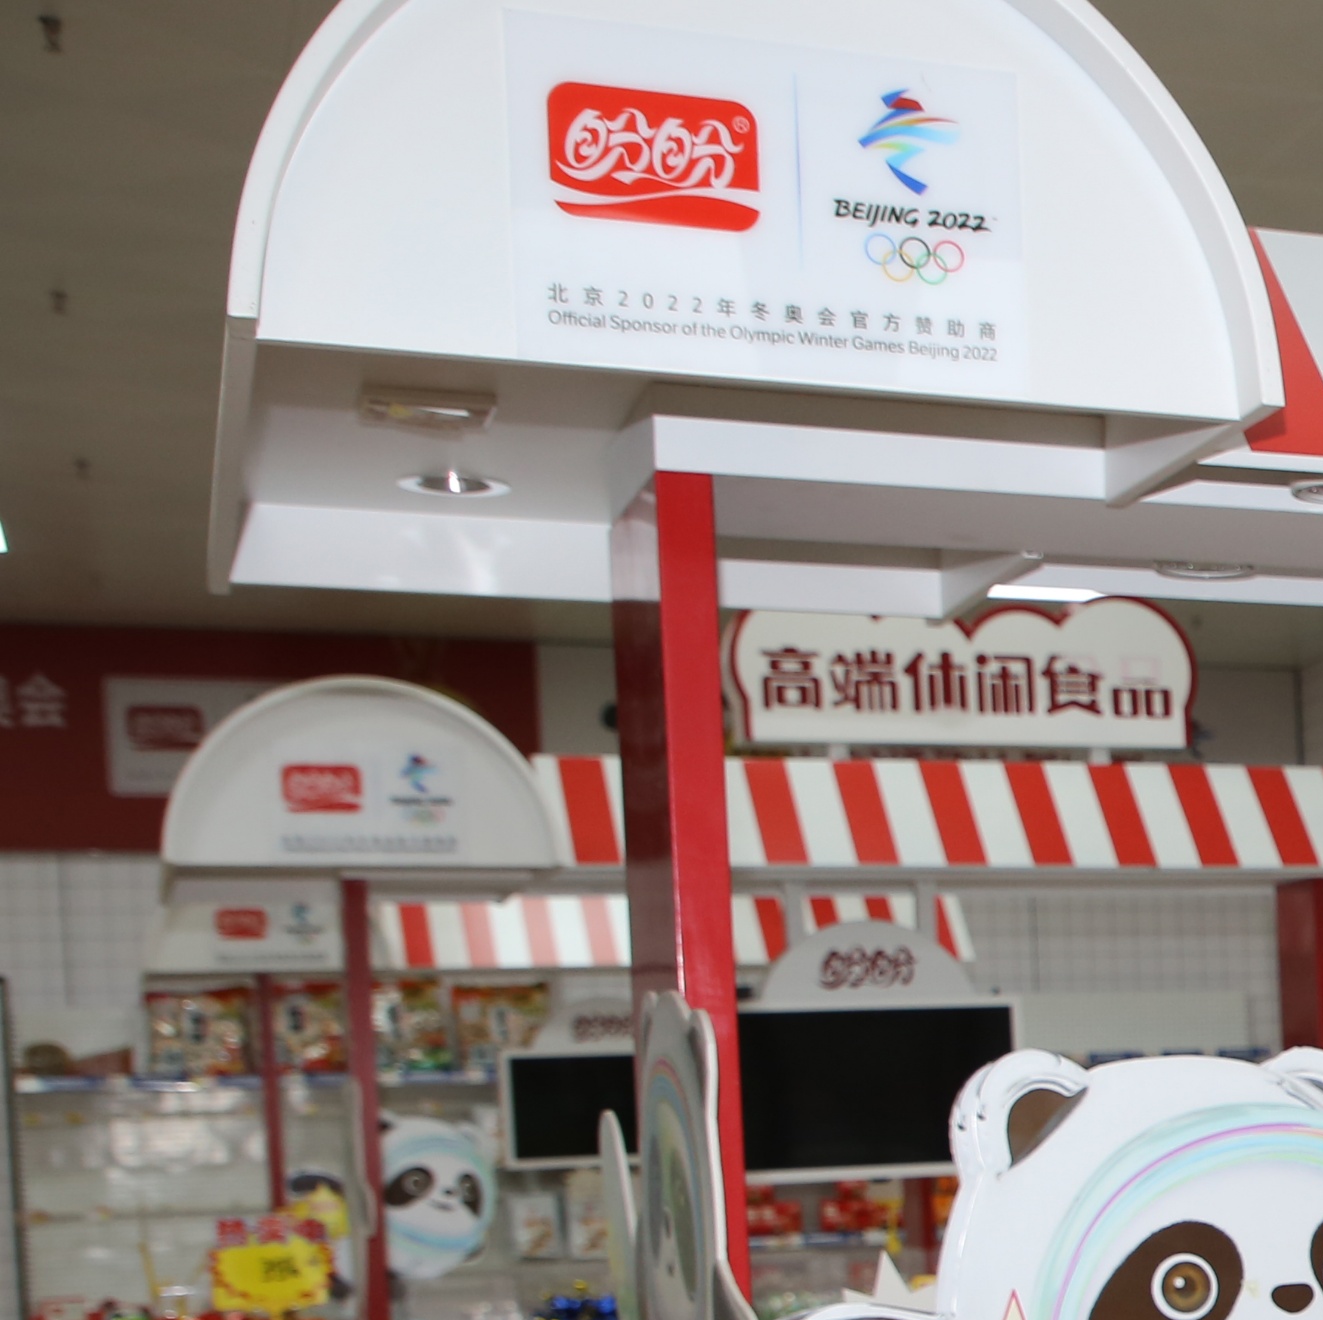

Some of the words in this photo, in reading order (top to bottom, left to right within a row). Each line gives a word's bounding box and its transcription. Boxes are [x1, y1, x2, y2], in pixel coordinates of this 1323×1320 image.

[556, 108, 744, 189] 盼盼
[834, 199, 918, 227] BEIJING
[927, 210, 992, 232] 2022
[548, 283, 997, 340] 北京2022年冬奥会官方赞助商
[549, 309, 605, 329] Official
[611, 315, 678, 338] Sponsor
[682, 320, 697, 337] of
[700, 322, 726, 338] the
[731, 326, 794, 346] Olympic
[798, 330, 848, 349] Winter
[852, 336, 904, 354] Games
[909, 340, 959, 360] Beijing
[963, 345, 997, 361] 2022
[760, 647, 1173, 718] 高端休闲食品
